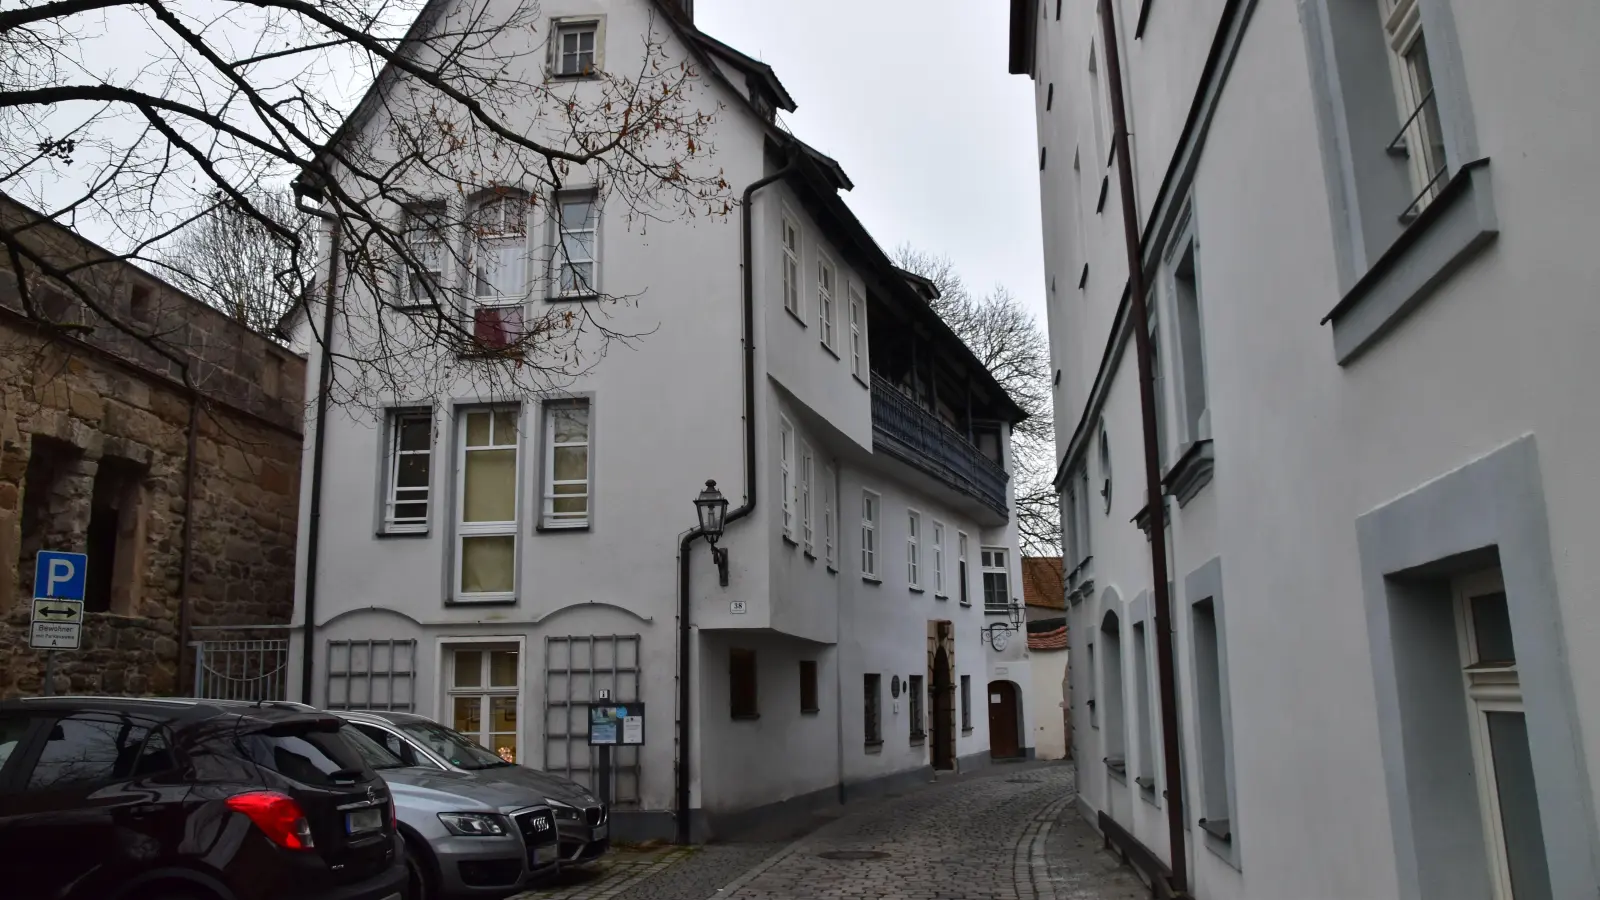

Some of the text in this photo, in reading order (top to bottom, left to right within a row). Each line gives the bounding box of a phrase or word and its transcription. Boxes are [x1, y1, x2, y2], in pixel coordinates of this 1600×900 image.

[47, 558, 75, 597] P
[733, 602, 743, 610] 38
[38, 624, 73, 632] Bewohner
